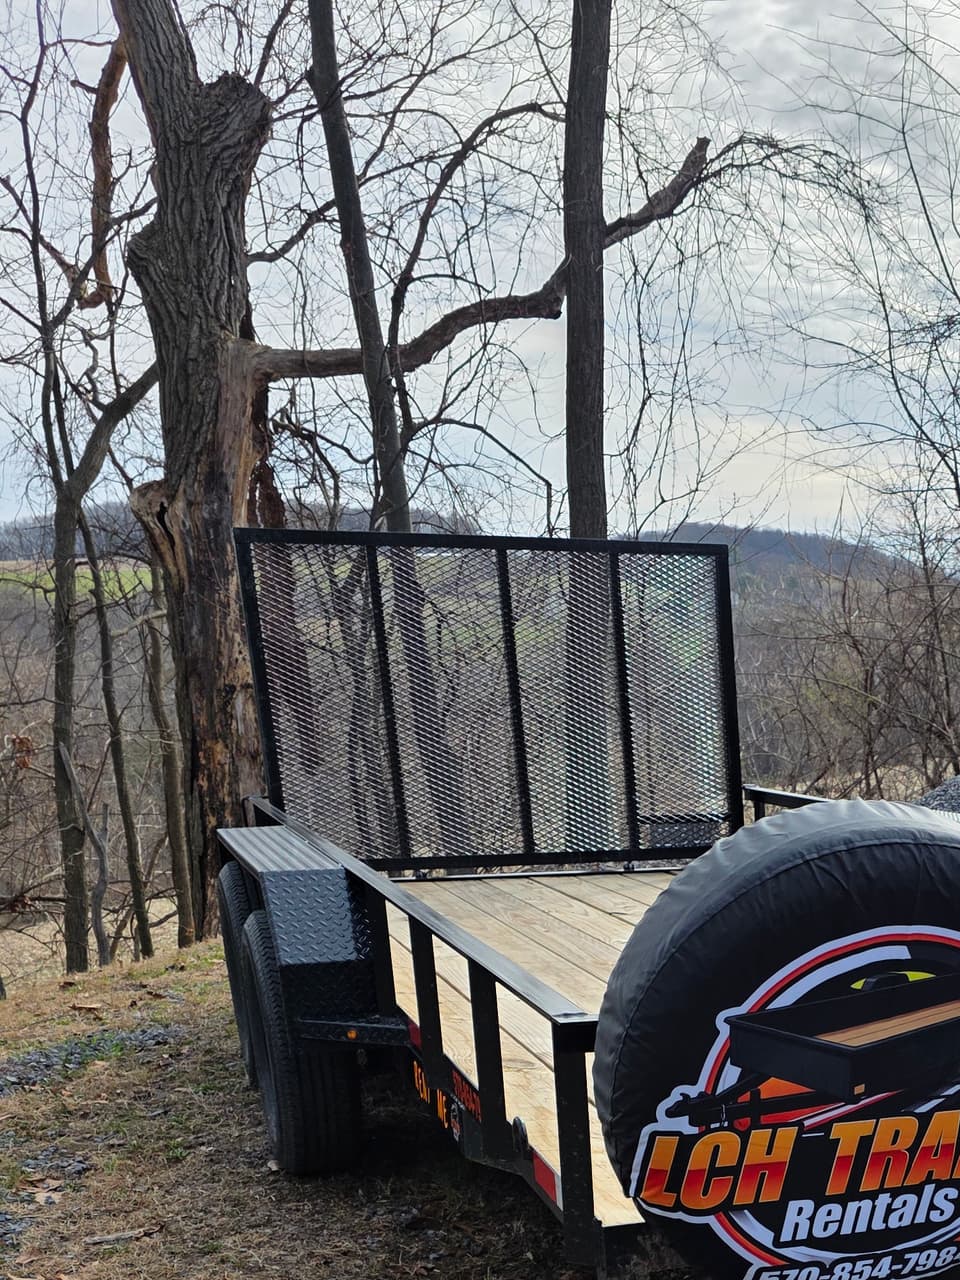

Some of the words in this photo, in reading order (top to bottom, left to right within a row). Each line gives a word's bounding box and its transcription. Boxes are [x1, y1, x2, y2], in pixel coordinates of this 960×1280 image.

[436, 1088, 449, 1129] ME
[640, 1126, 799, 1210] LCH
[779, 1183, 960, 1243] Rentals
